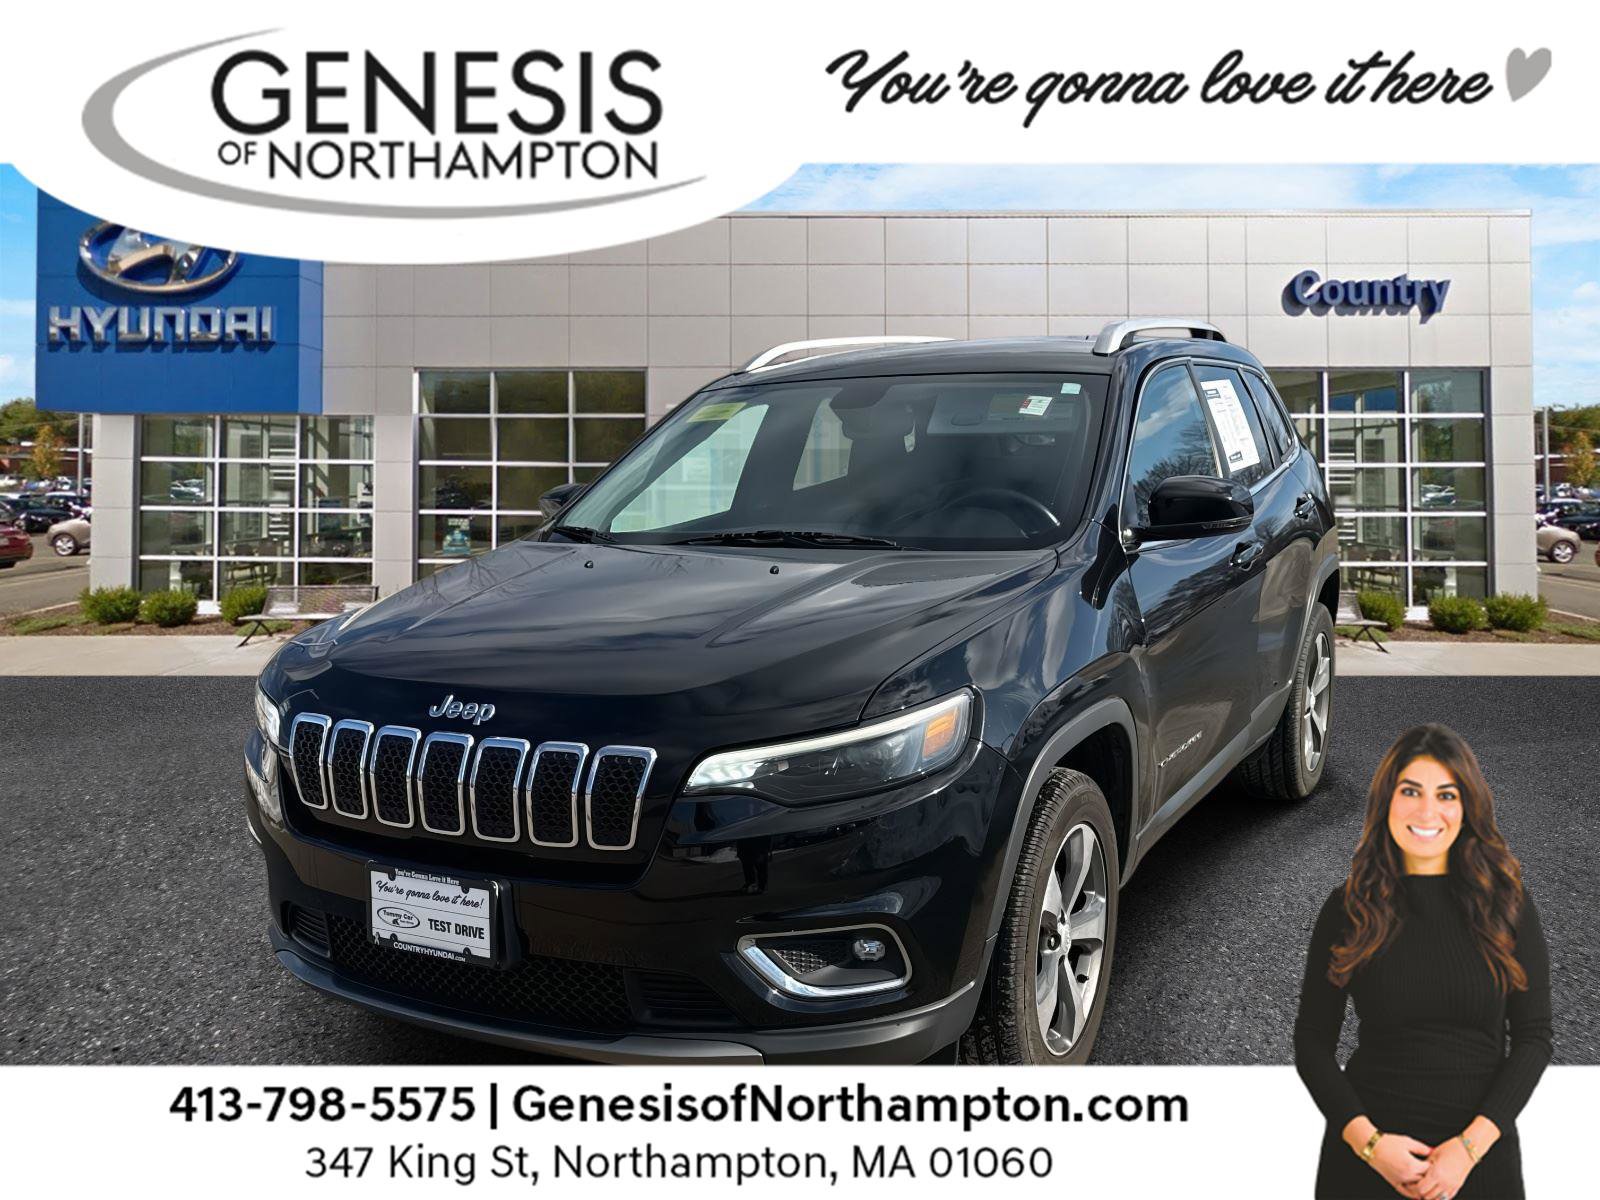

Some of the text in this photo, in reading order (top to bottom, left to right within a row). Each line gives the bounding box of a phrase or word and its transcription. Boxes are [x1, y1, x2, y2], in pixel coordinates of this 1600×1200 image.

[1283, 269, 1451, 323] Country
[49, 306, 264, 342] HYUNDAI
[428, 694, 496, 725] Jeep
[376, 880, 485, 909] You're gonna love it here!
[427, 917, 485, 940] TEST DRIVE
